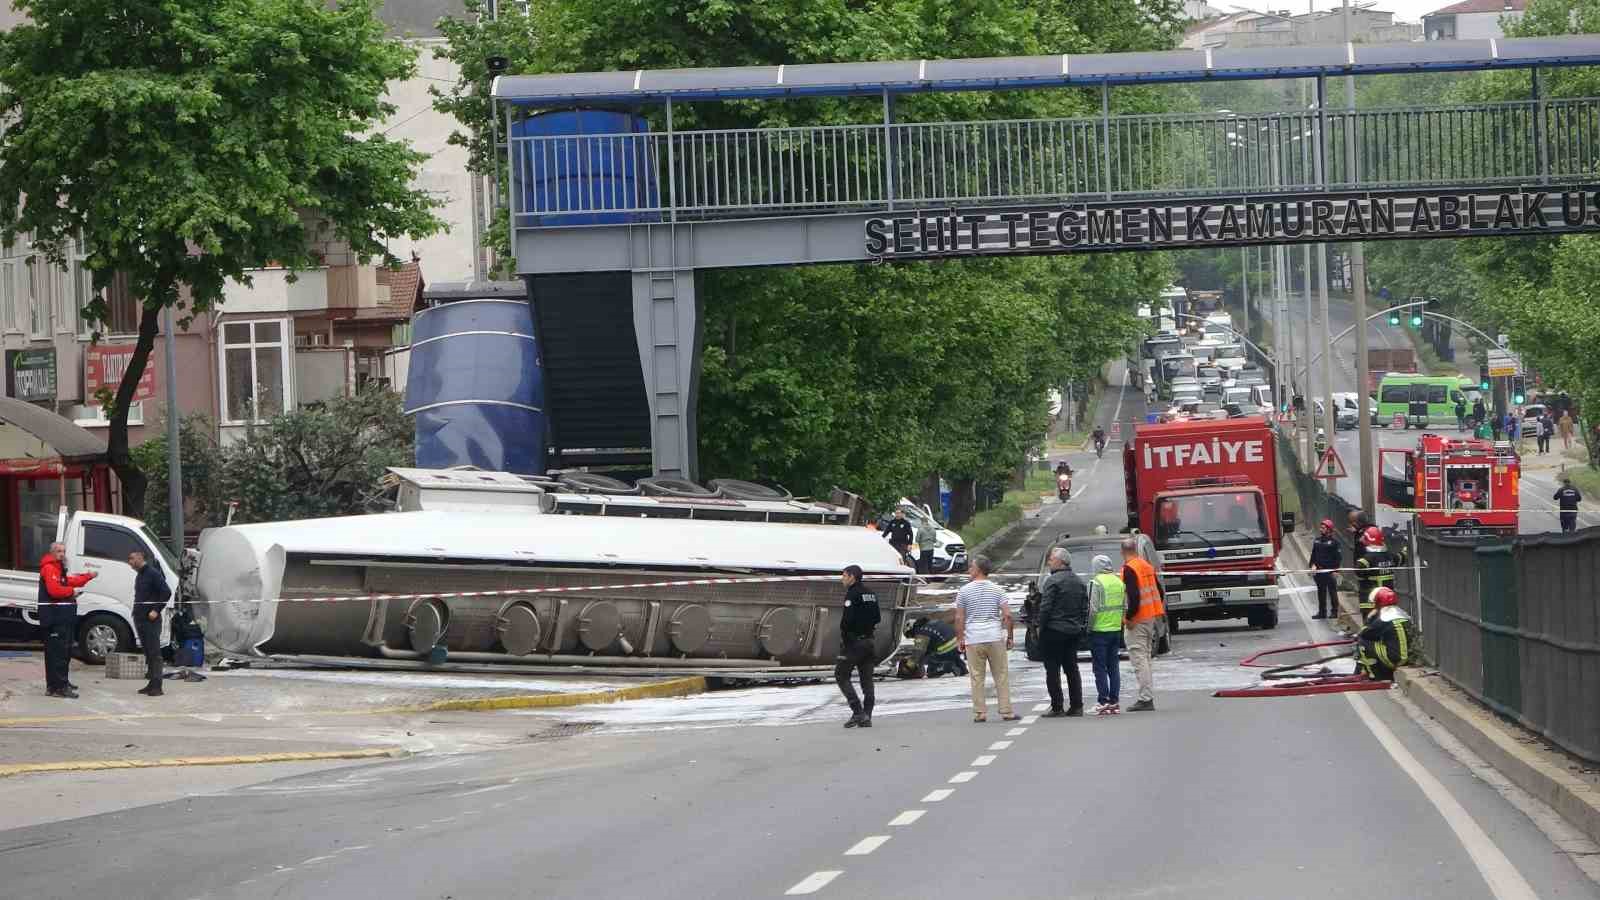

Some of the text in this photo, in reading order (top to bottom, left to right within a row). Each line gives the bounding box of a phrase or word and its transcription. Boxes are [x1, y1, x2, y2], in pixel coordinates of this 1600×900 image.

[865, 187, 1600, 264] ŞEHİT TEĞMEN KAMURAN ABLAK Ü
[1143, 437, 1264, 469] İTFAİYE
